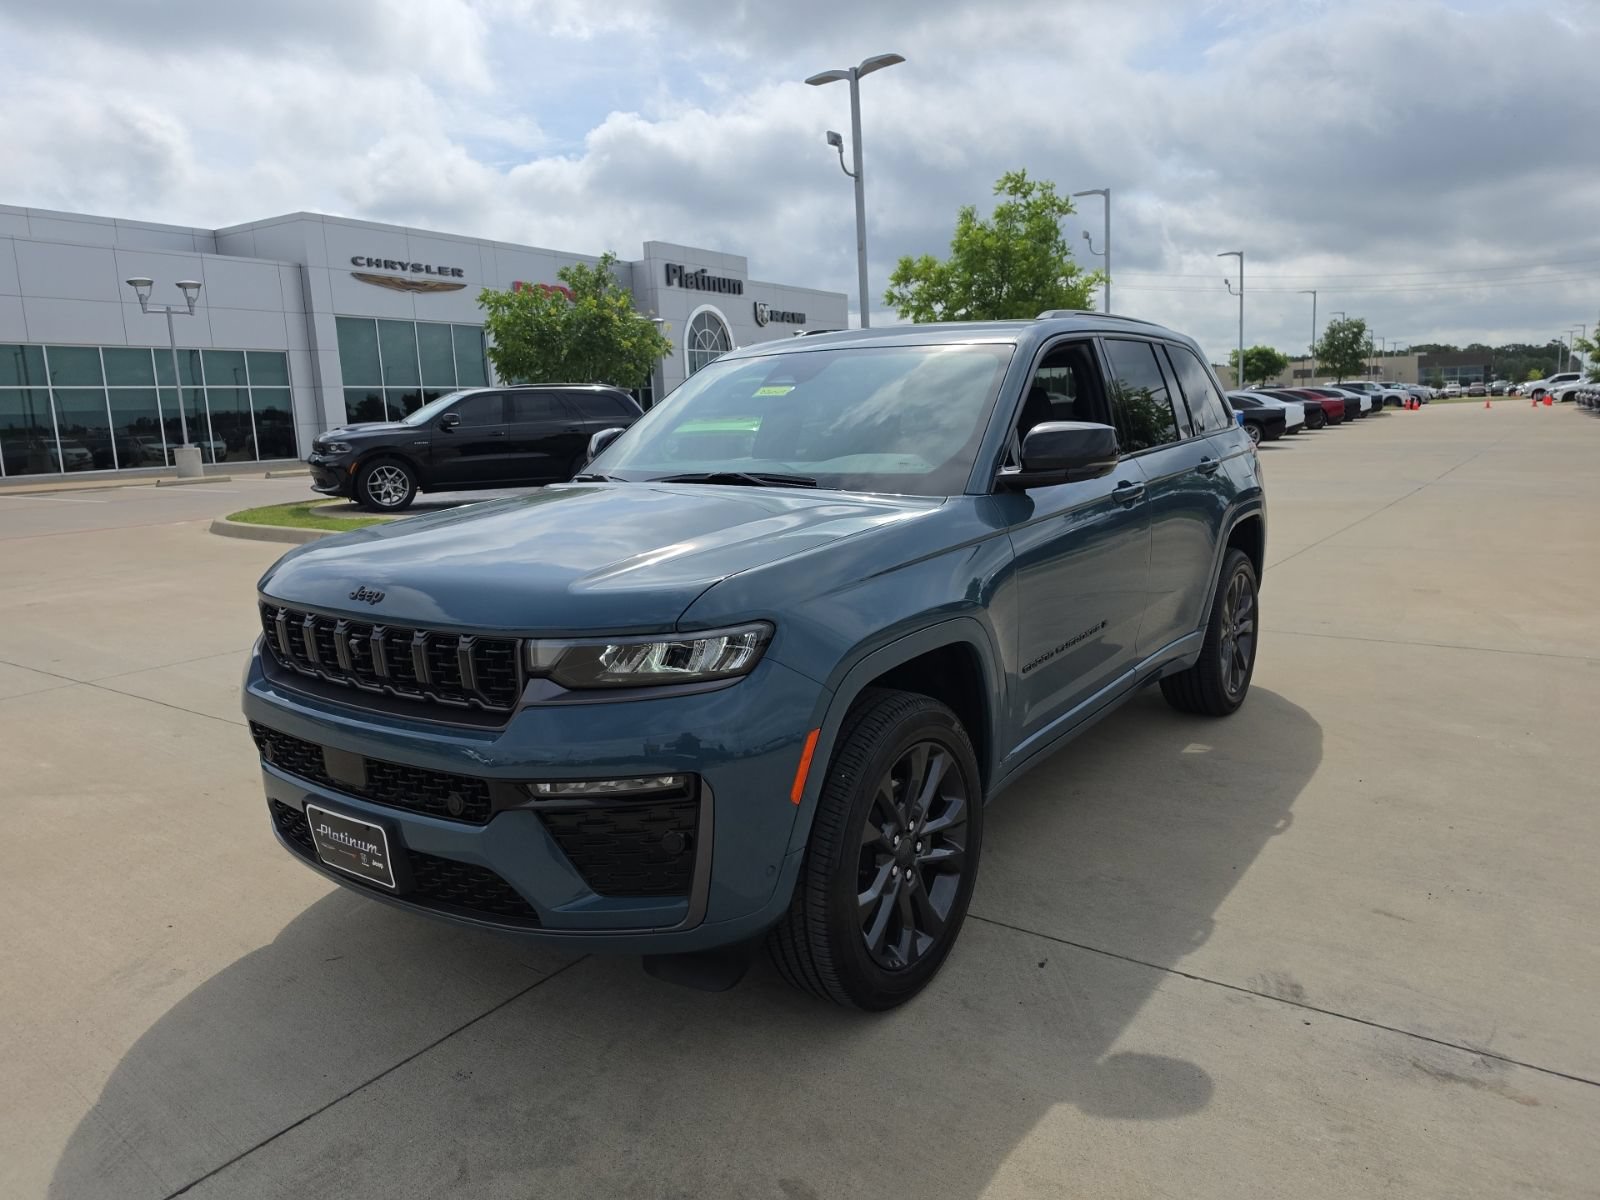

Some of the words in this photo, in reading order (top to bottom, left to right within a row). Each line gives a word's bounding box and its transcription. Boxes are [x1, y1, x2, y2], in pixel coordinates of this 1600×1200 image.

[350, 255, 464, 278] CHRYSLER
[665, 262, 744, 296] Platinum
[769, 309, 806, 325] RAM
[349, 585, 386, 606] Jeep
[316, 823, 382, 857] Platinum
